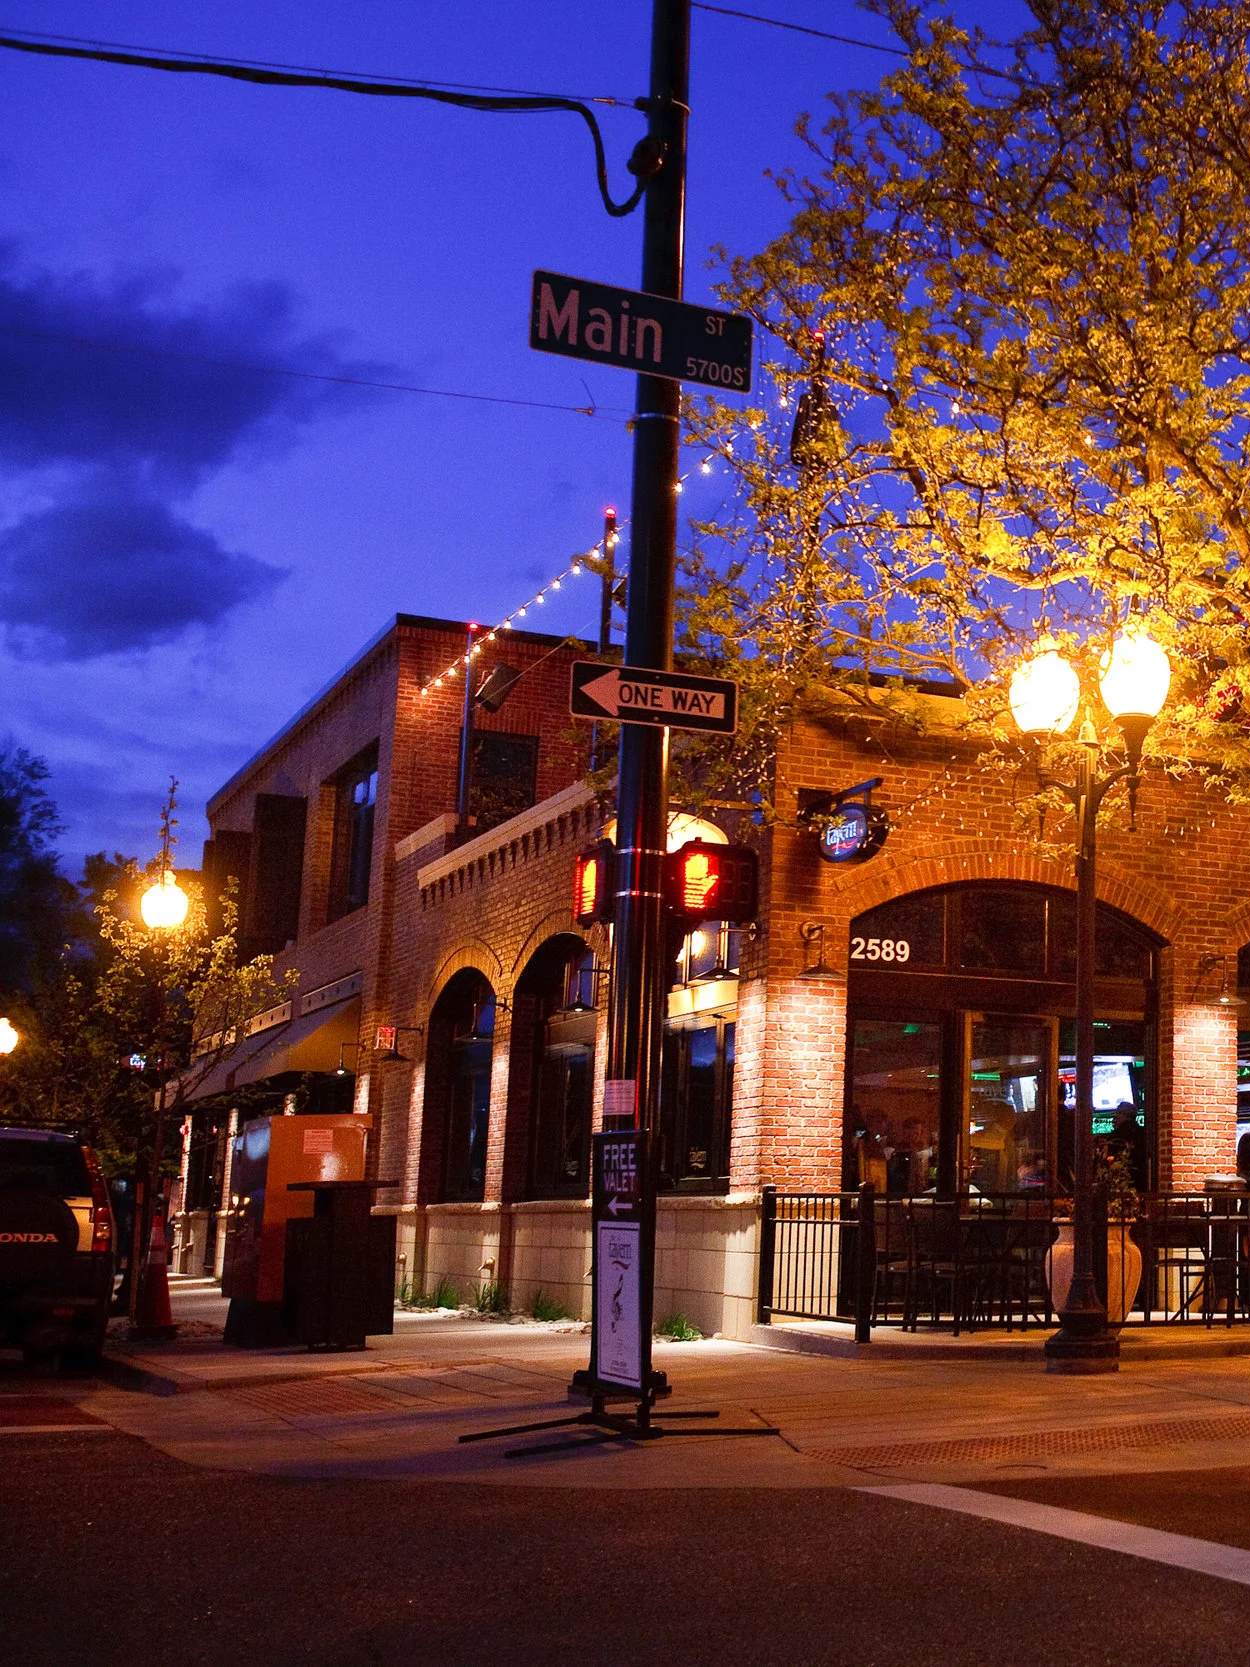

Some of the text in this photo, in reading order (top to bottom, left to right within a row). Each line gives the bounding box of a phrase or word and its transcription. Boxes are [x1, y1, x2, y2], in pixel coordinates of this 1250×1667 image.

[538, 282, 726, 363] Main ST
[686, 357, 744, 386] 5700S
[619, 683, 716, 714] ONE WAY
[851, 937, 910, 962] 2589
[603, 1143, 637, 1170] FREE
[603, 1171, 636, 1192] VALET
